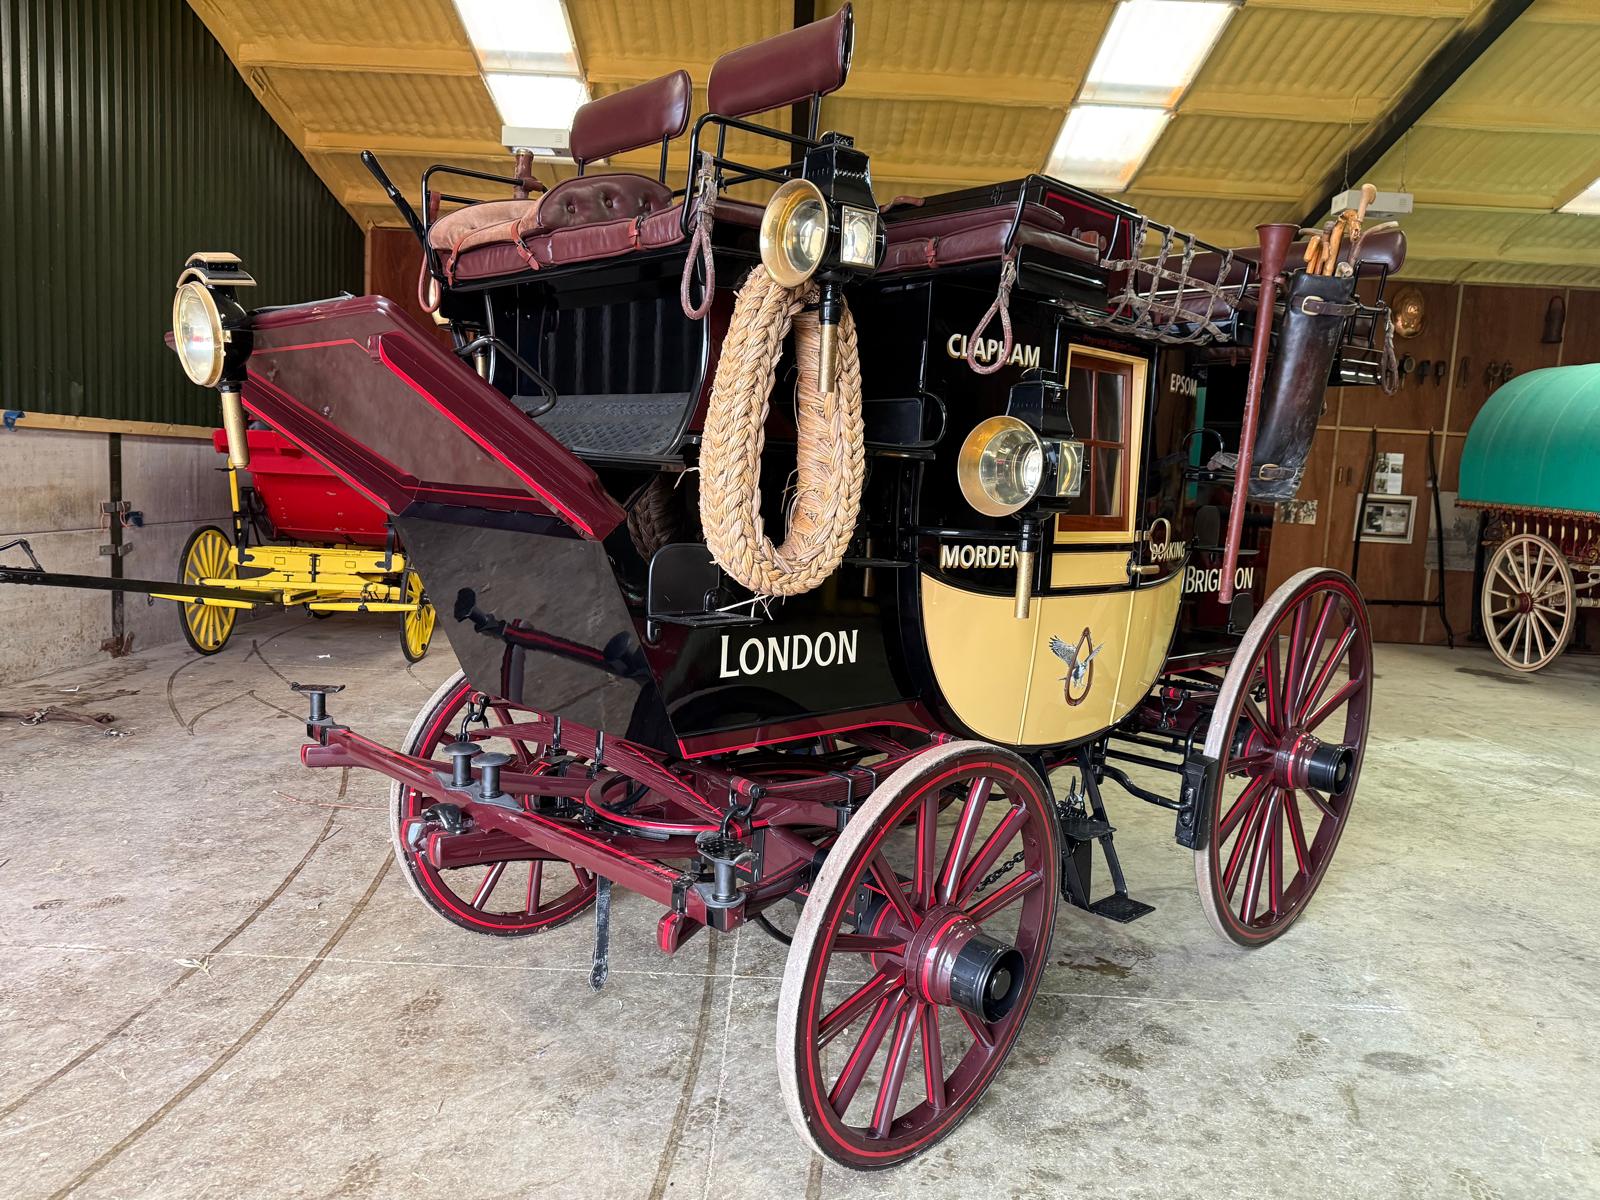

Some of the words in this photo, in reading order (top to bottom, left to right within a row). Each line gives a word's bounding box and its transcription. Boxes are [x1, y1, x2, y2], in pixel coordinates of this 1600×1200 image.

[1170, 373, 1197, 396] EPSOM
[1185, 566, 1253, 593] BRIGON
[720, 629, 858, 678] LONDON
